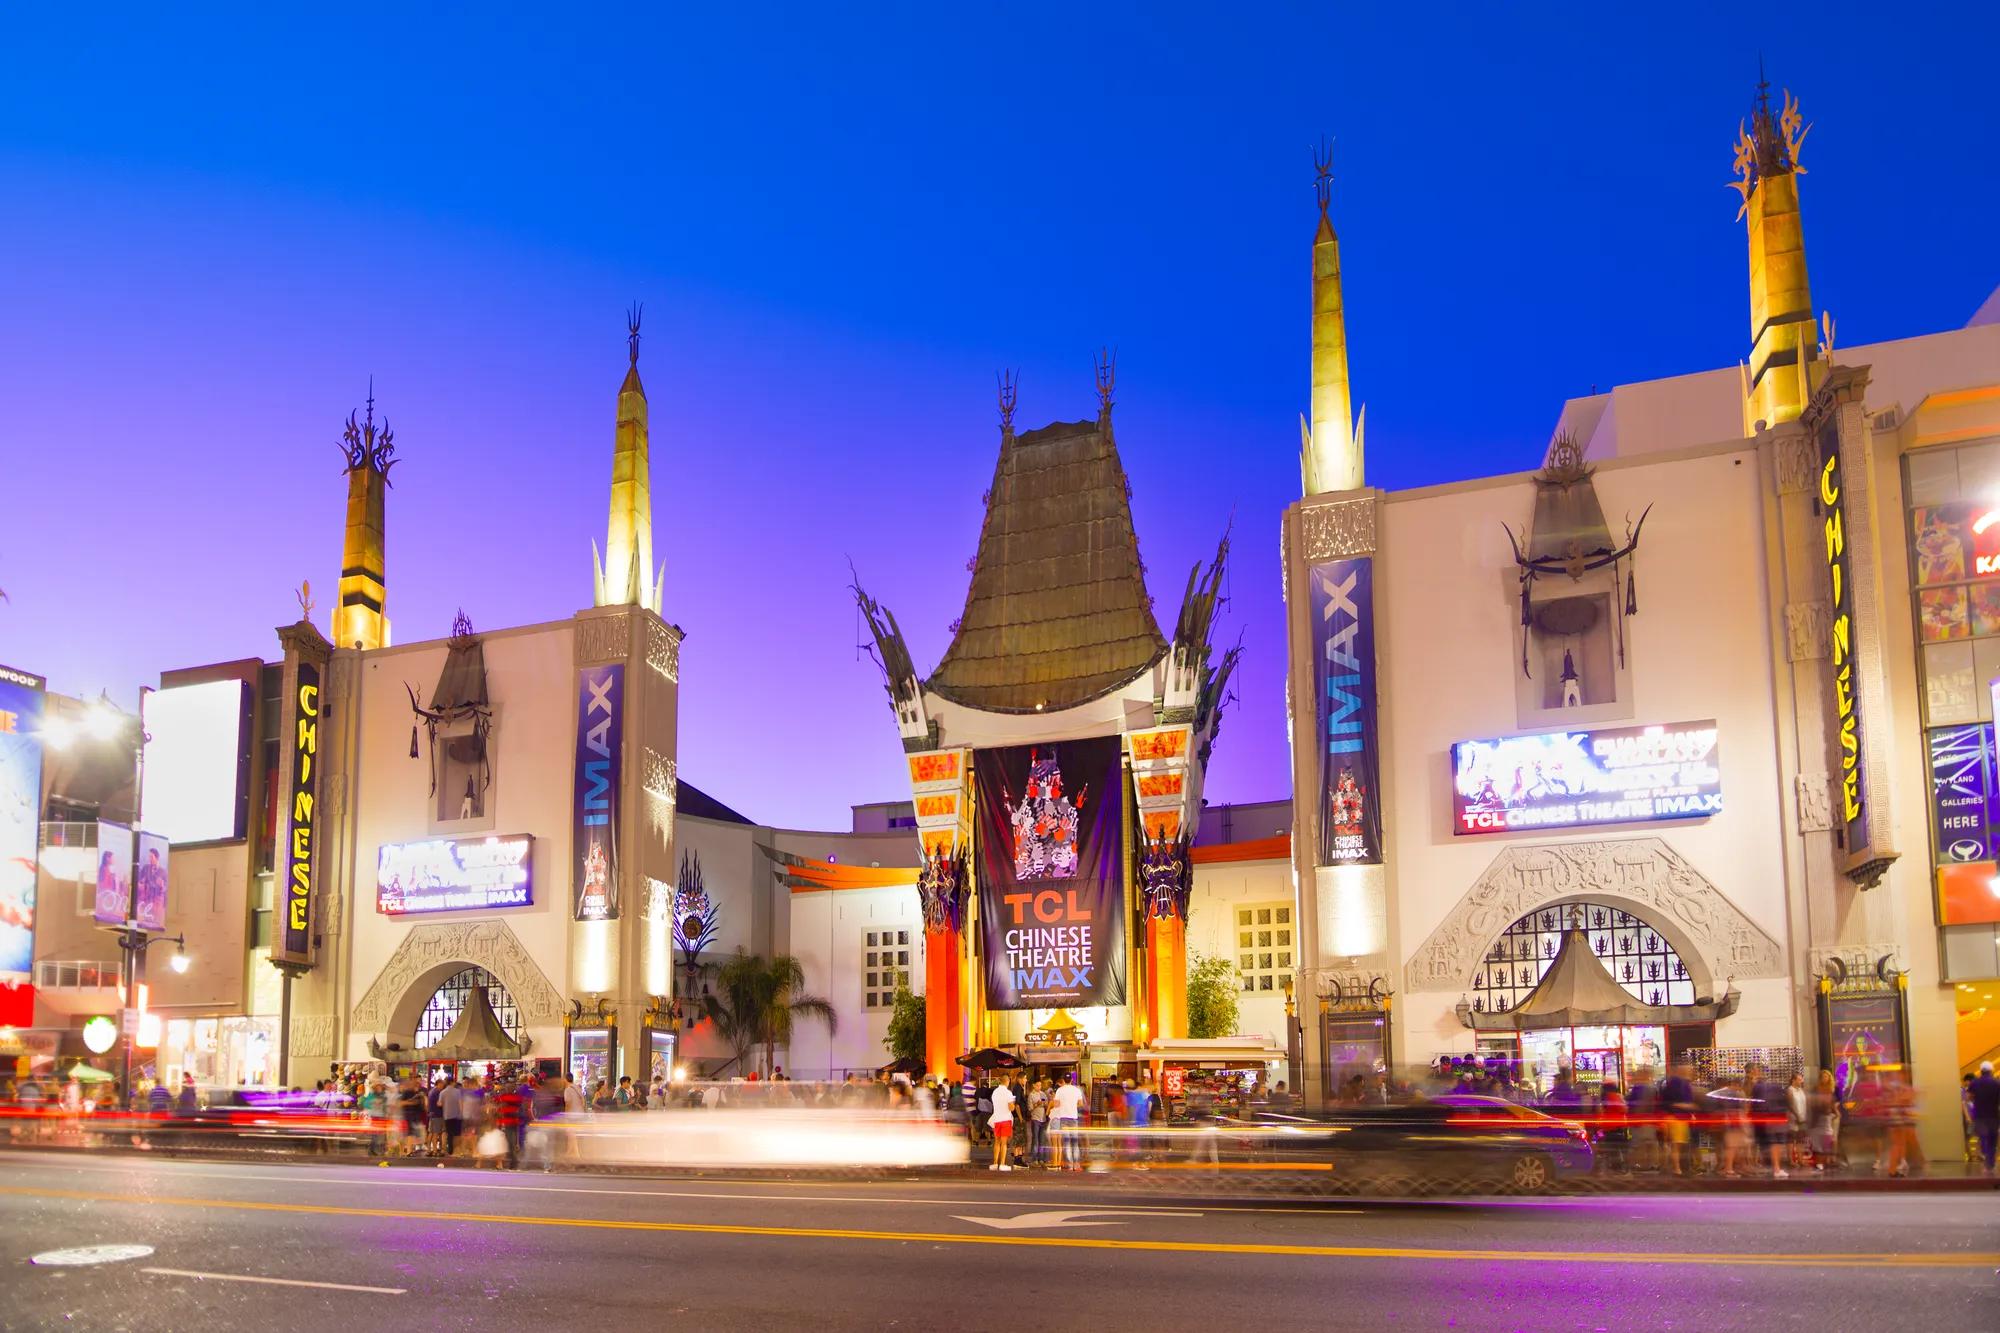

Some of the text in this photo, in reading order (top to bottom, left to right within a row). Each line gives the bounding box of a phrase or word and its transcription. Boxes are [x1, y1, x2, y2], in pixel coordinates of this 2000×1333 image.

[1821, 455, 1861, 823] CHINESE
[1322, 570, 1364, 754] IMAX
[584, 674, 613, 826] IMAX
[1940, 775, 1975, 785] WYLAND
[290, 685, 319, 931] CHINESE
[1462, 812, 1506, 829] TCL
[1655, 794, 1721, 814] IMAX
[1941, 796, 1984, 807] GALLERIES
[1943, 815, 1979, 829] HERE
[1332, 848, 1368, 859] IMAX
[1004, 890, 1092, 924] TCL
[1005, 926, 1092, 950] CHINESE
[1006, 946, 1092, 969] THEATRE
[1009, 966, 1092, 991] IMAX
[1167, 1076, 1182, 1091] $5
